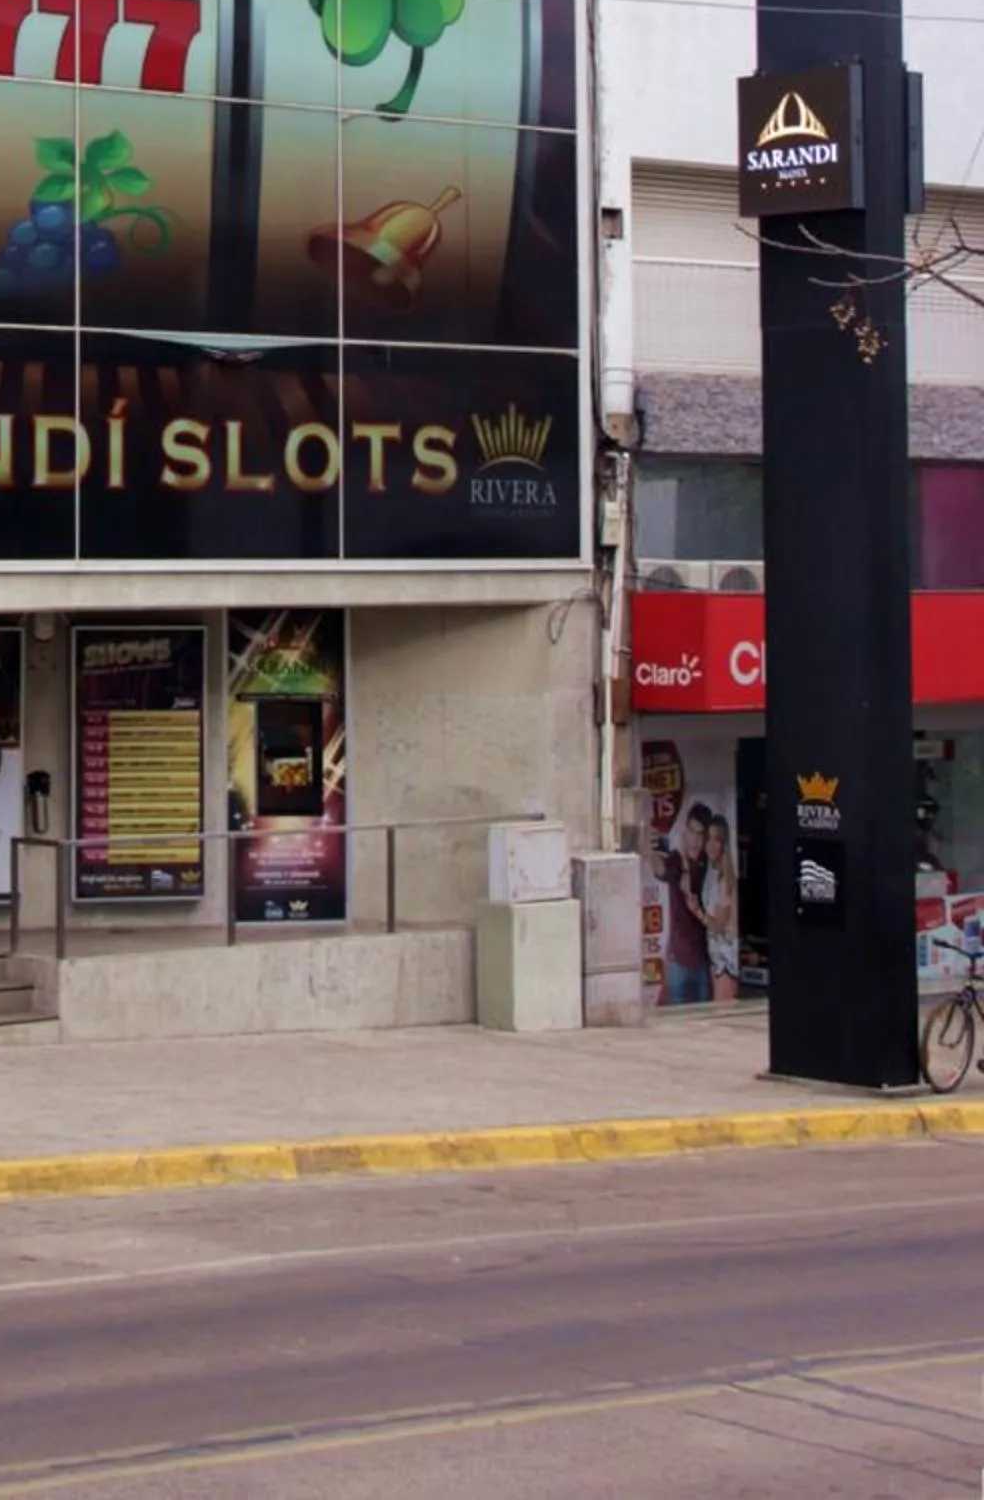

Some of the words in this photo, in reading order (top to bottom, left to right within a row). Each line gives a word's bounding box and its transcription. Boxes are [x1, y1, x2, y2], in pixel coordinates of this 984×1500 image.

[747, 144, 838, 171] SARANDI
[159, 416, 460, 493] SLOTS
[469, 477, 558, 506] RIVERA
[82, 637, 173, 668] SHOWS
[635, 662, 693, 687] Claro
